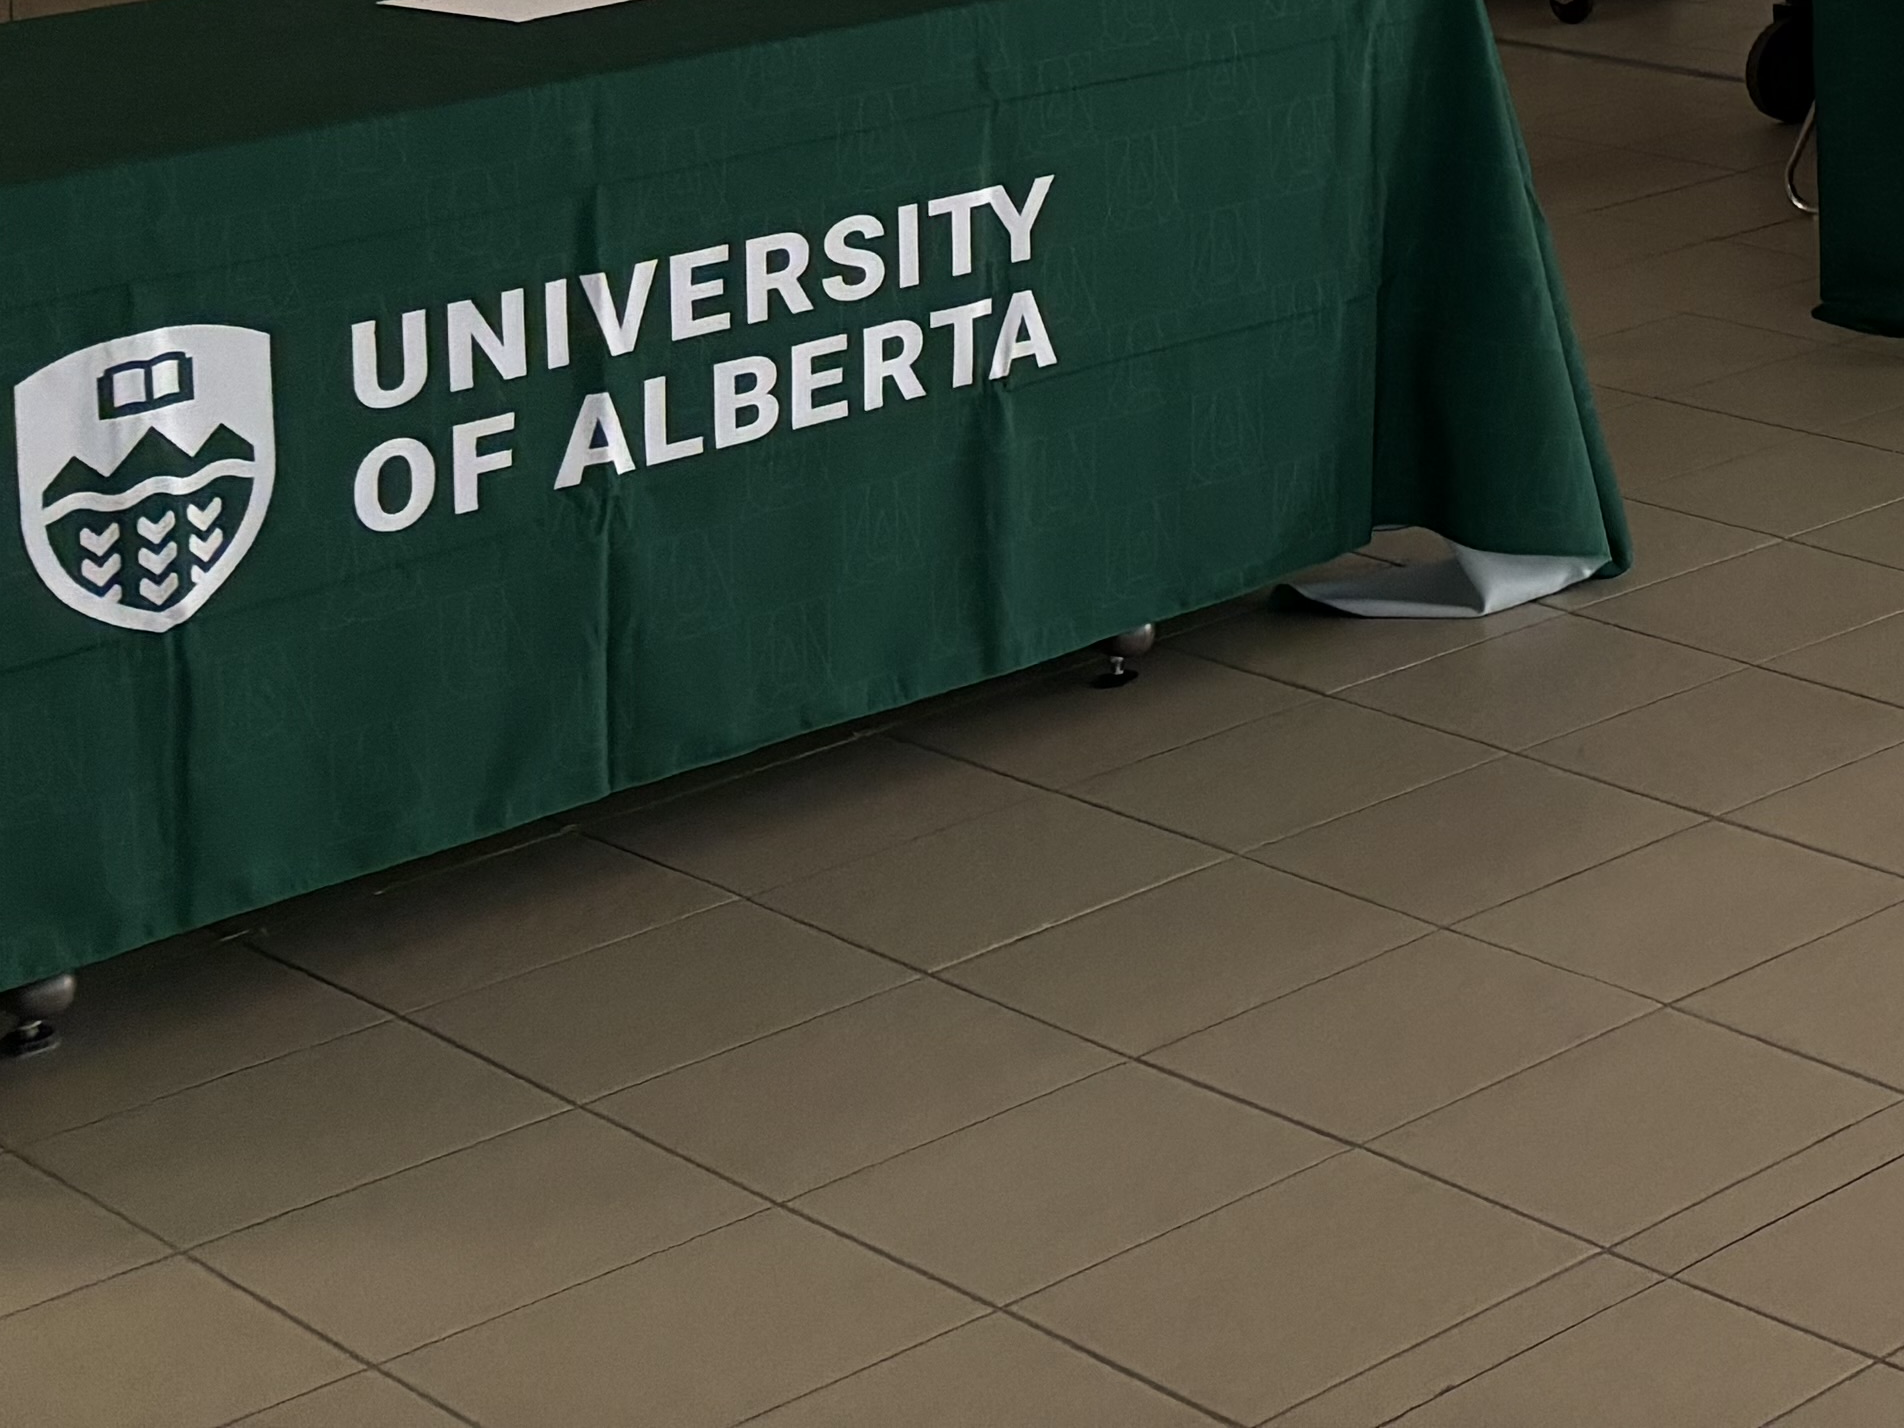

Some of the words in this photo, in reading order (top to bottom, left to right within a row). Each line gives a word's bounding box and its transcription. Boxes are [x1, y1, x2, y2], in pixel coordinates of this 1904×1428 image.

[352, 174, 1056, 410] UNIVERSITY
[354, 412, 516, 533] OF
[553, 289, 1058, 490] ALBERTA
